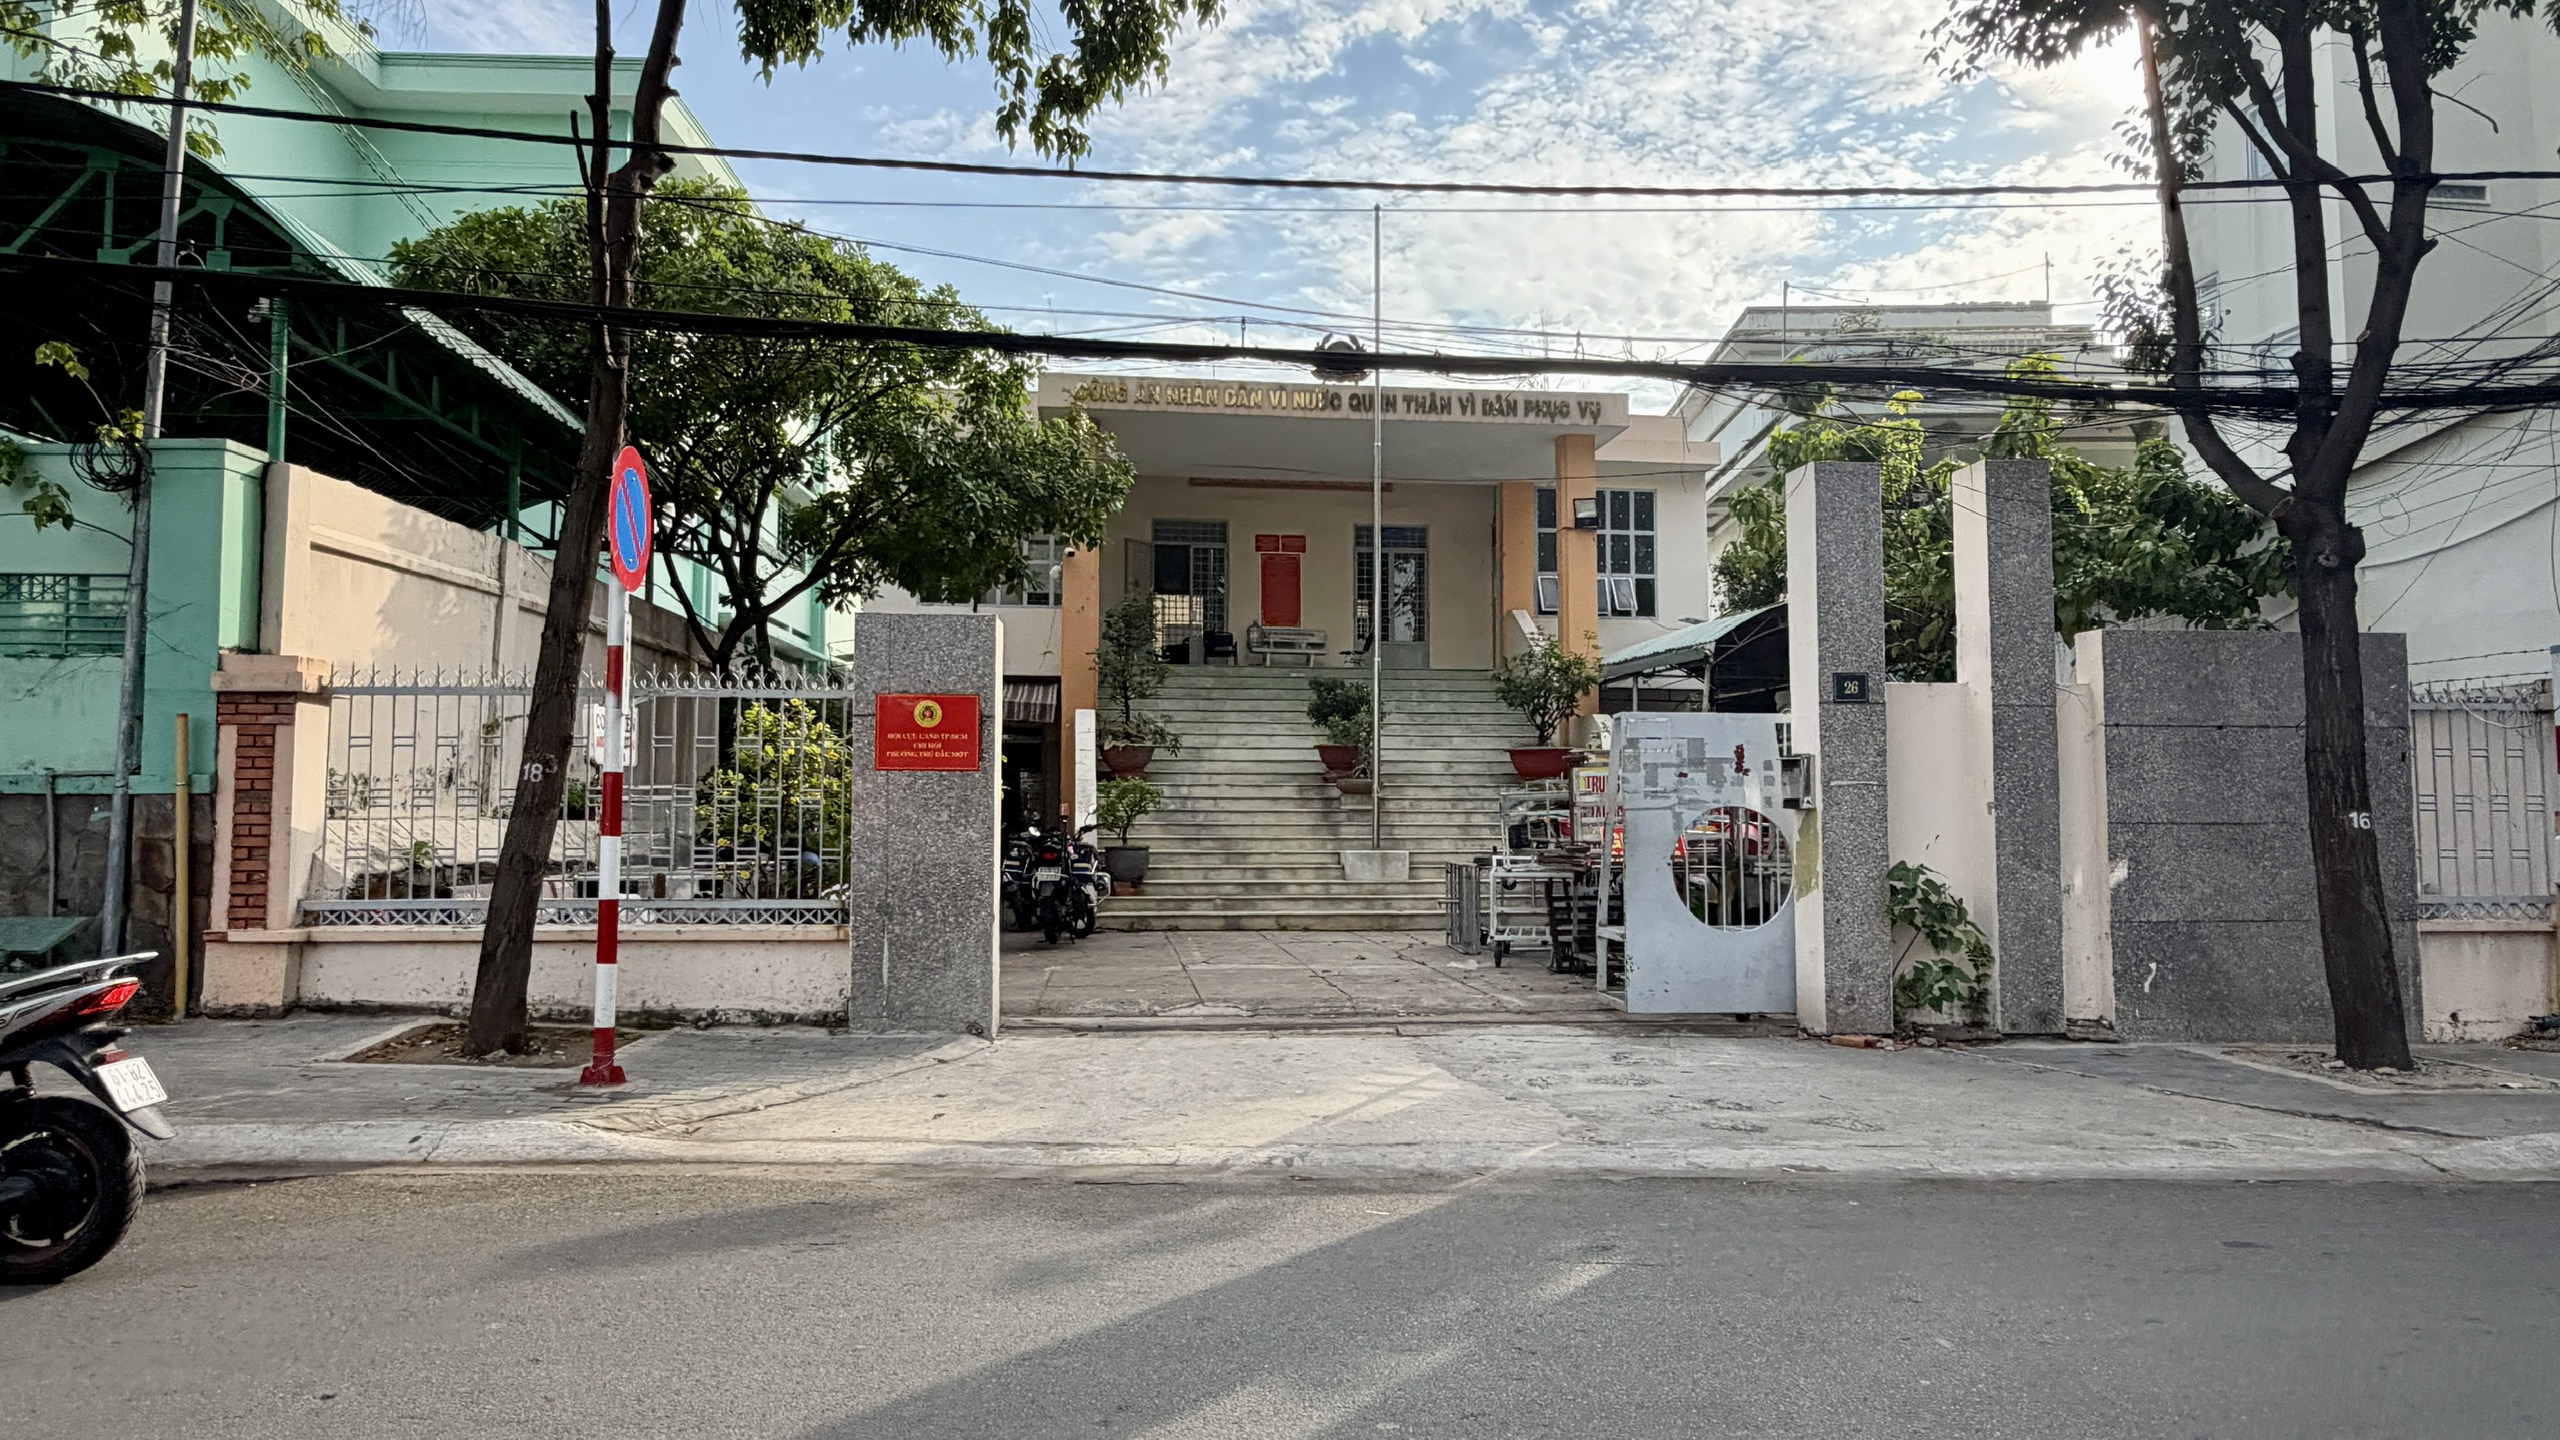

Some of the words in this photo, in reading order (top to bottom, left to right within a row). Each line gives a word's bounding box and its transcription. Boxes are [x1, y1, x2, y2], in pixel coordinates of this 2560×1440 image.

[1134, 383, 1161, 405] AN
[1166, 383, 1218, 408] NHÂN
[1224, 383, 1263, 410] DÂN
[1268, 385, 1288, 410] VÌ
[1293, 388, 1343, 412] NƯỚC
[1402, 391, 1453, 416] THÂN
[1457, 392, 1477, 416] VÌ
[1481, 394, 1519, 418] DÂN
[1523, 399, 1571, 424] PHỤC
[1576, 400, 1602, 426] VỤ
[1843, 680, 1860, 695] 26
[523, 762, 543, 782] 18
[2348, 811, 2371, 830] 16
